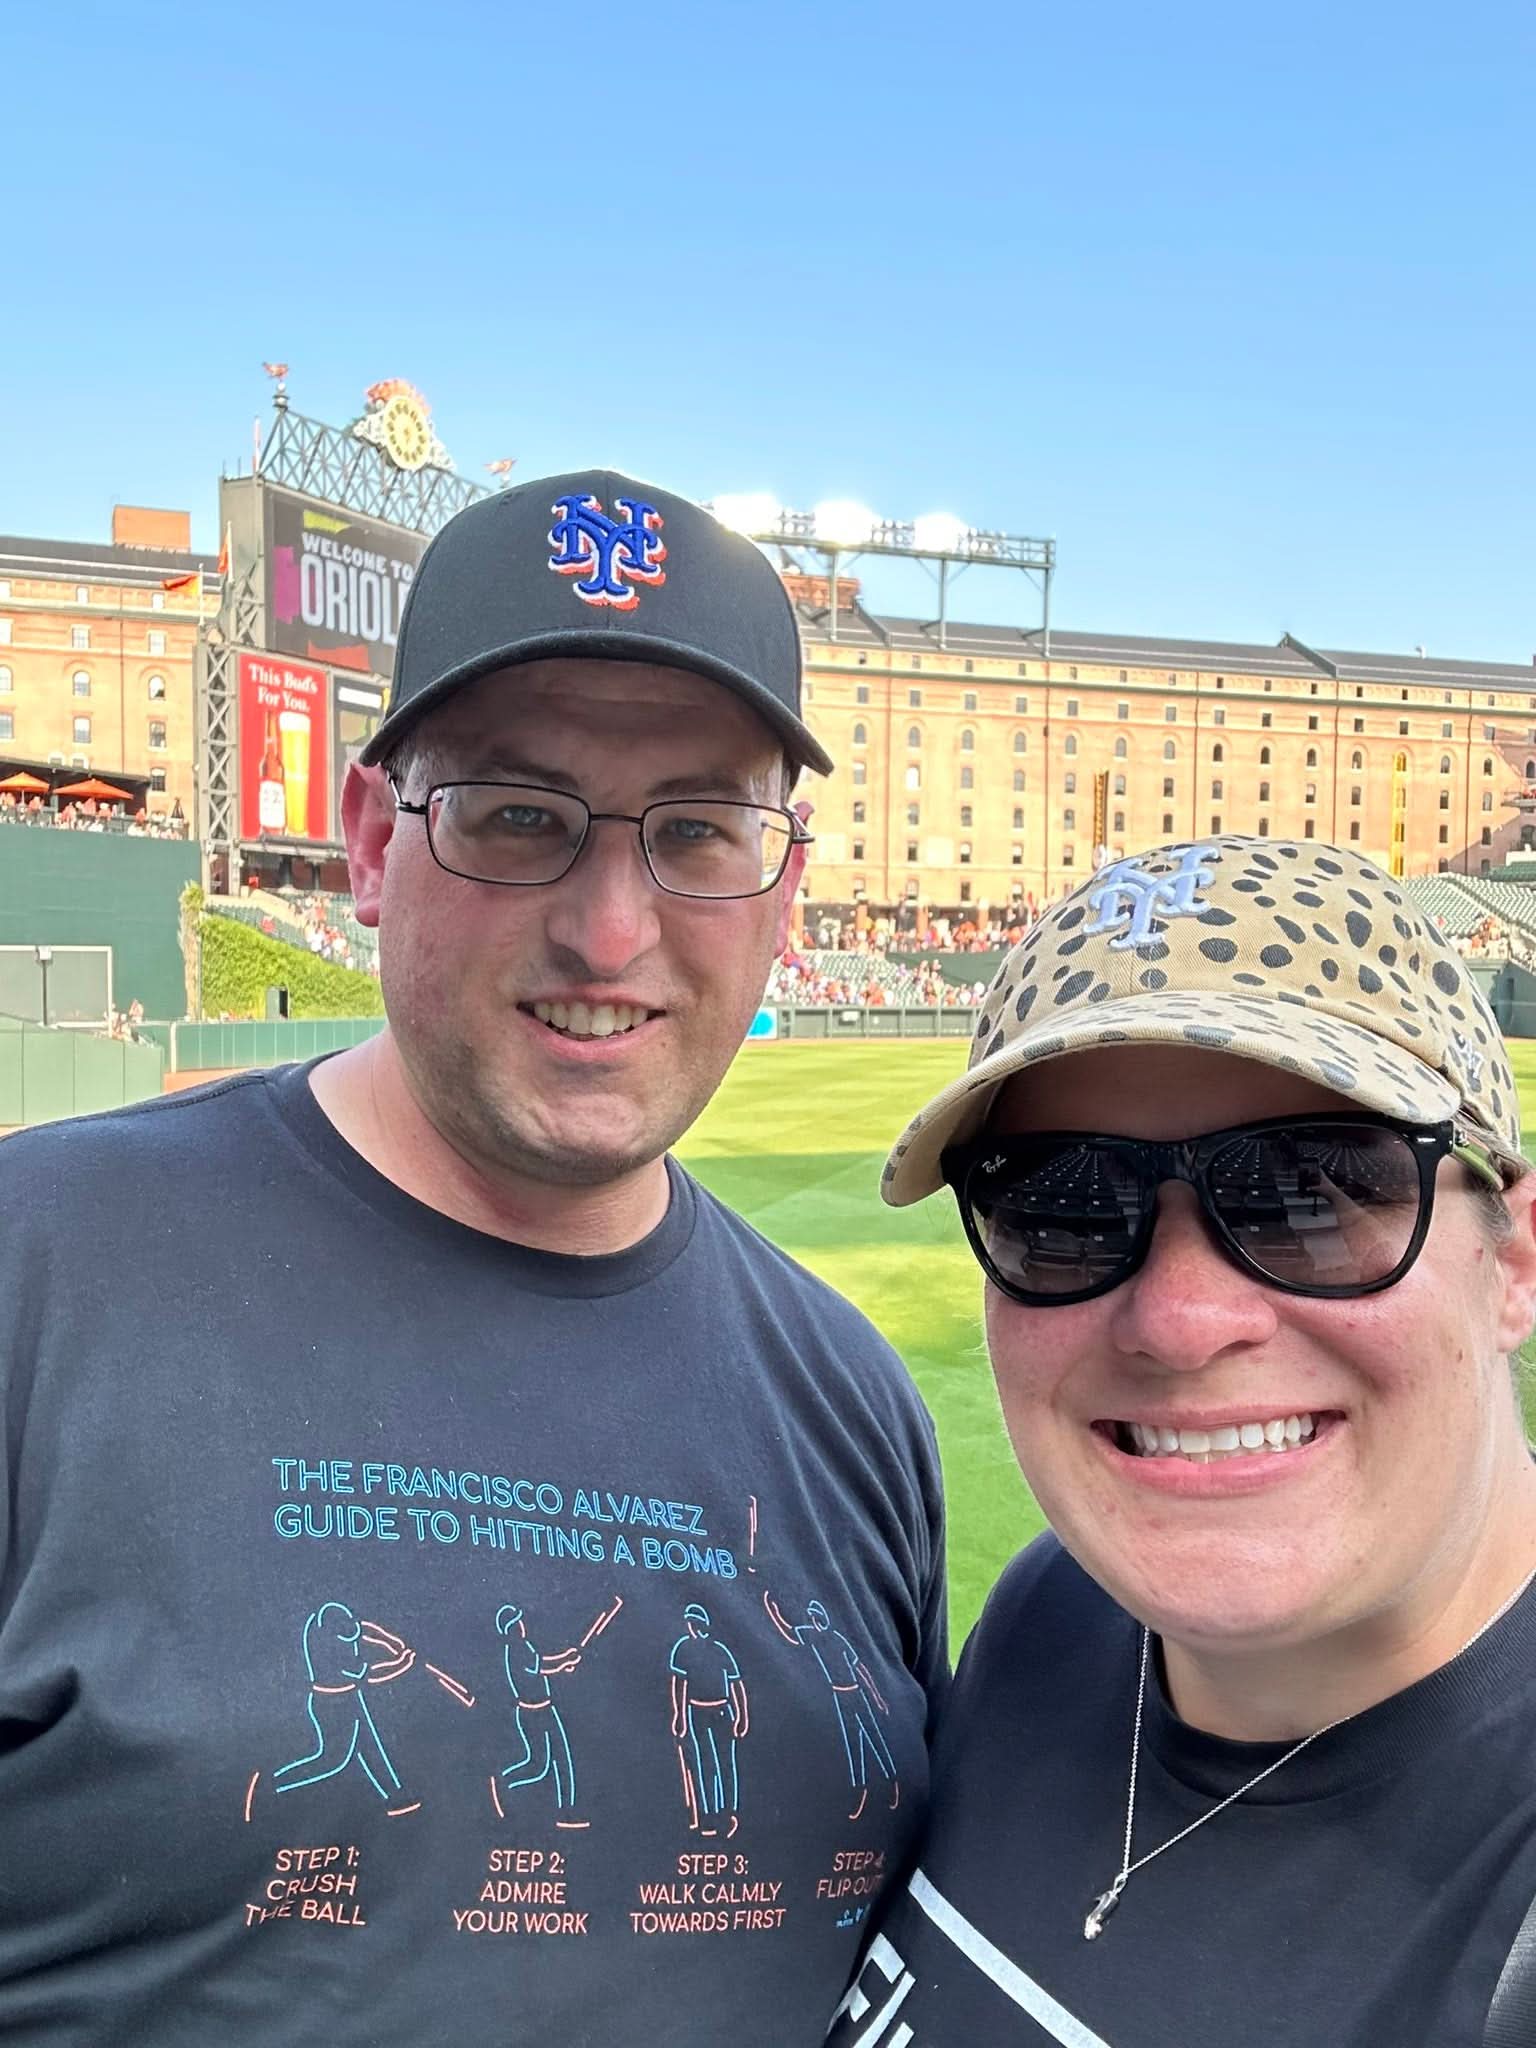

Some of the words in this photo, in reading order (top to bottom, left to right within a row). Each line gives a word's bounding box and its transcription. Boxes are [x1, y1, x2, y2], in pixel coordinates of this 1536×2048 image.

[302, 532, 387, 575] WELCOME
[390, 560, 414, 580] TO
[249, 663, 281, 687] This
[284, 671, 318, 694] Bud's
[258, 687, 280, 706] For
[282, 690, 310, 712] You.
[272, 1459, 354, 1494] THE
[362, 1463, 564, 1515] FRANCISCO
[573, 1489, 707, 1536] ALVAREZ
[274, 1504, 400, 1540] GUIDE
[407, 1508, 460, 1543] TO
[470, 1514, 605, 1562] HITTING
[613, 1535, 635, 1567] A
[641, 1537, 738, 1579] BOMB
[275, 1847, 340, 1872] STEP
[347, 1845, 360, 1867] 1:
[488, 1849, 544, 1873] STEP
[548, 1851, 565, 1874] 2:
[678, 1854, 728, 1875] STEP
[733, 1854, 749, 1875] 3:
[833, 1851, 874, 1872] STEP
[266, 1873, 357, 1900] CRUSH
[480, 1880, 567, 1904] ADMIRE
[639, 1883, 695, 1904] WALK
[702, 1881, 783, 1904] CALMLY
[816, 1878, 851, 1899] FLIP
[245, 1899, 296, 1927] THE
[301, 1899, 366, 1926] BALL
[453, 1910, 519, 1933] YOUR
[524, 1912, 589, 1935] WORK
[630, 1911, 729, 1934] TOWARDS
[733, 1908, 787, 1930] FIRST
